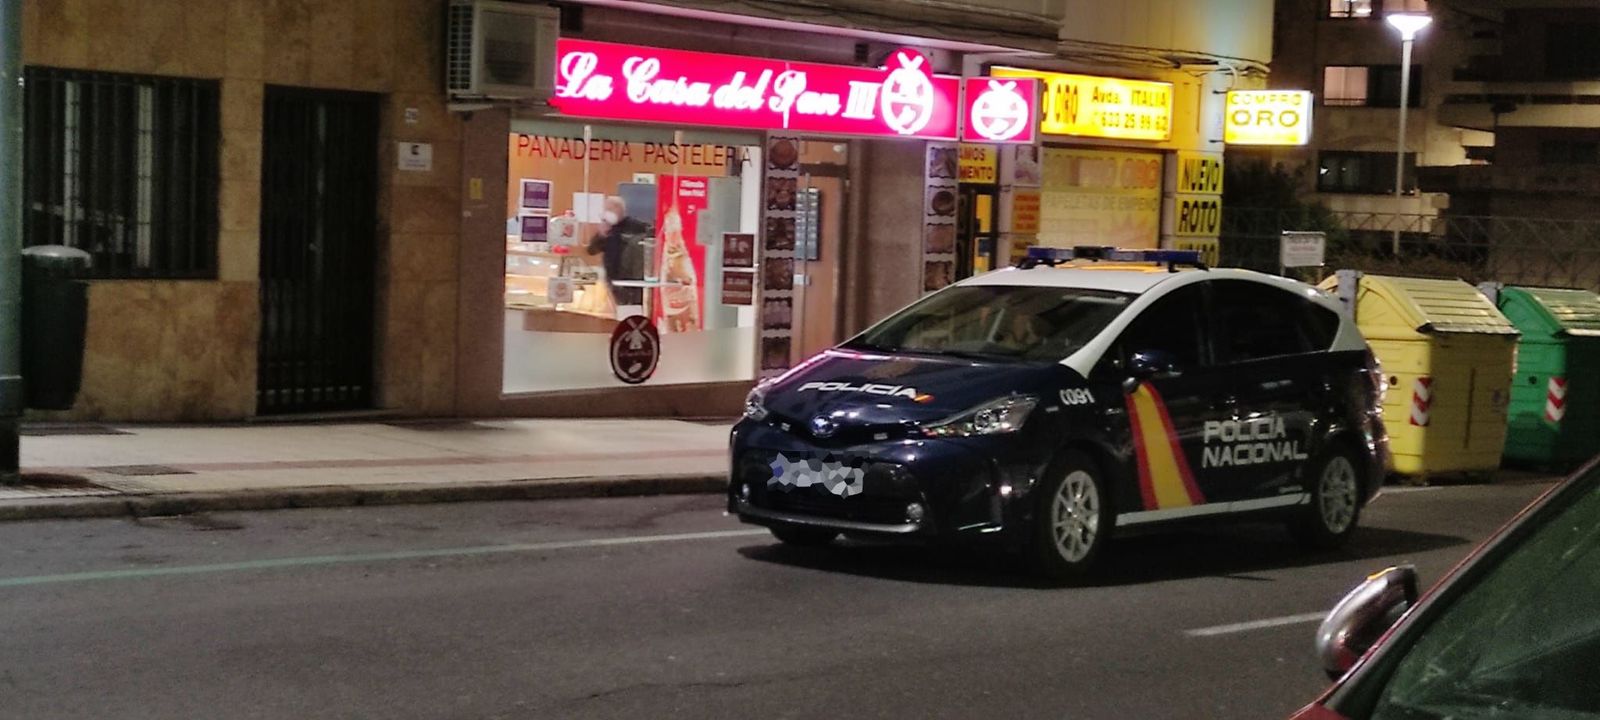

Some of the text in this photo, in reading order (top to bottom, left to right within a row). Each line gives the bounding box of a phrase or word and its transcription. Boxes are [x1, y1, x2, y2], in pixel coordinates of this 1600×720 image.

[556, 51, 882, 120] La Casa del Pan III
[1130, 89, 1167, 107] ITALIA
[1231, 93, 1302, 106] COMPRO
[1055, 83, 1079, 124] ORO
[1124, 112, 1136, 129] 25
[1231, 109, 1300, 128] ORO
[518, 134, 633, 162] PANADERIA
[1183, 158, 1220, 192] NUEVO
[1178, 200, 1218, 233] ROTO
[1202, 440, 1309, 469] NACIONAL
